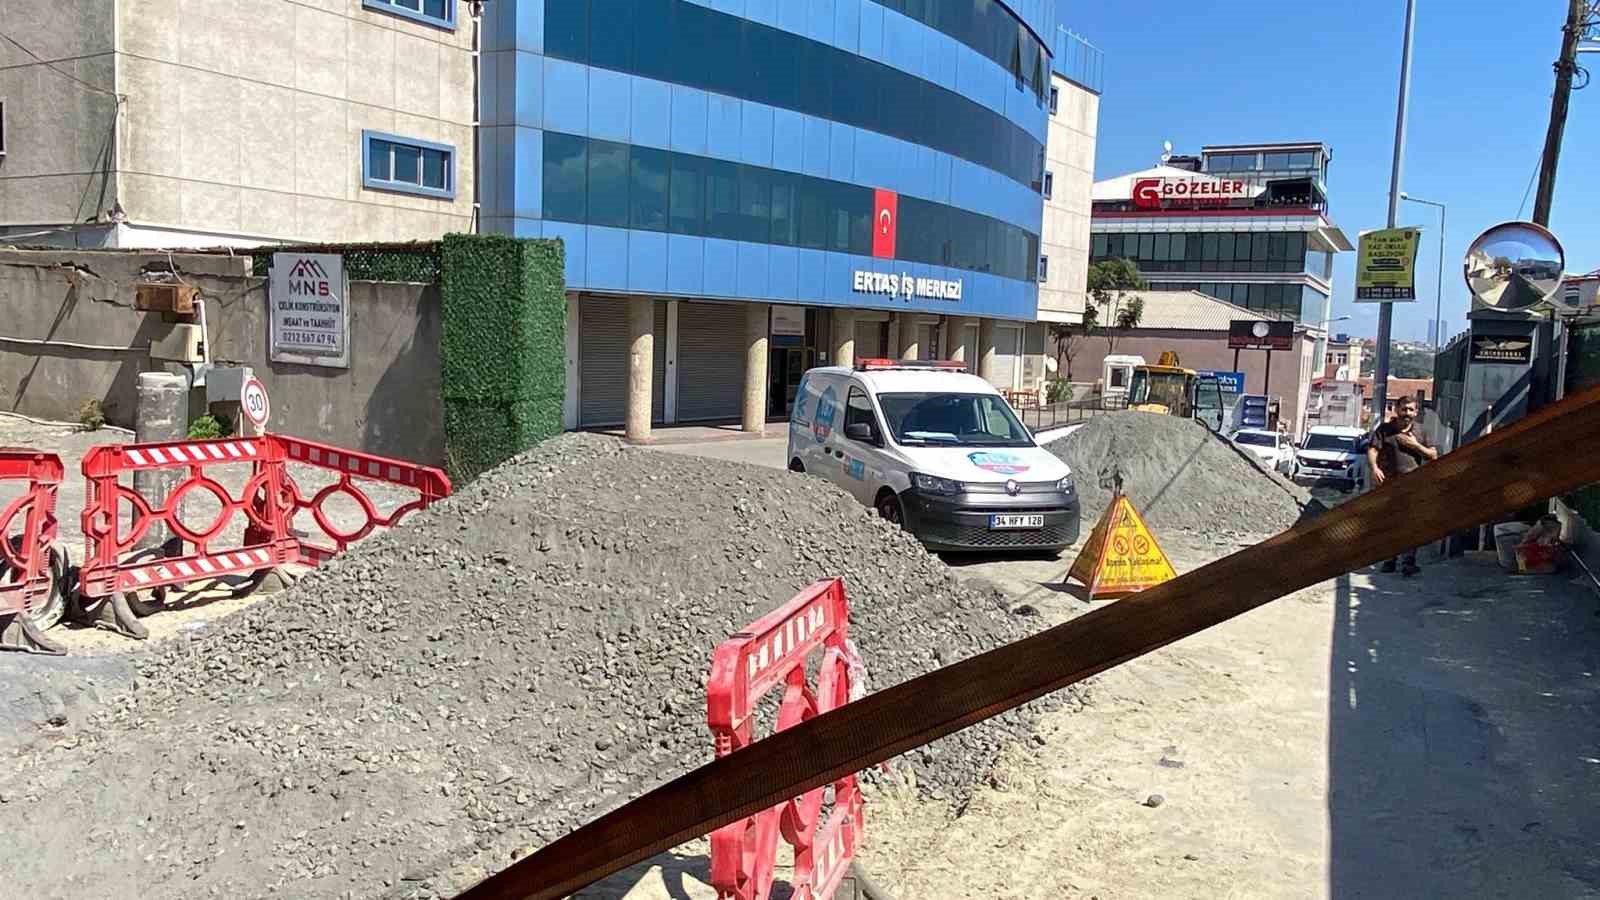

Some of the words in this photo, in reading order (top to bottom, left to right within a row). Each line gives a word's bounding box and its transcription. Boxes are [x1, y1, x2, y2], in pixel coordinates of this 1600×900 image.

[1163, 178, 1242, 194] GÖZELER
[289, 280, 330, 296] MNS
[854, 271, 898, 298] ERTAŞ
[901, 271, 914, 301] İŞ
[917, 277, 962, 300] MERKEZİ
[283, 332, 300, 342] 0212
[248, 393, 263, 412] 30
[996, 516, 1006, 526] 34
[1028, 516, 1042, 526] 128
